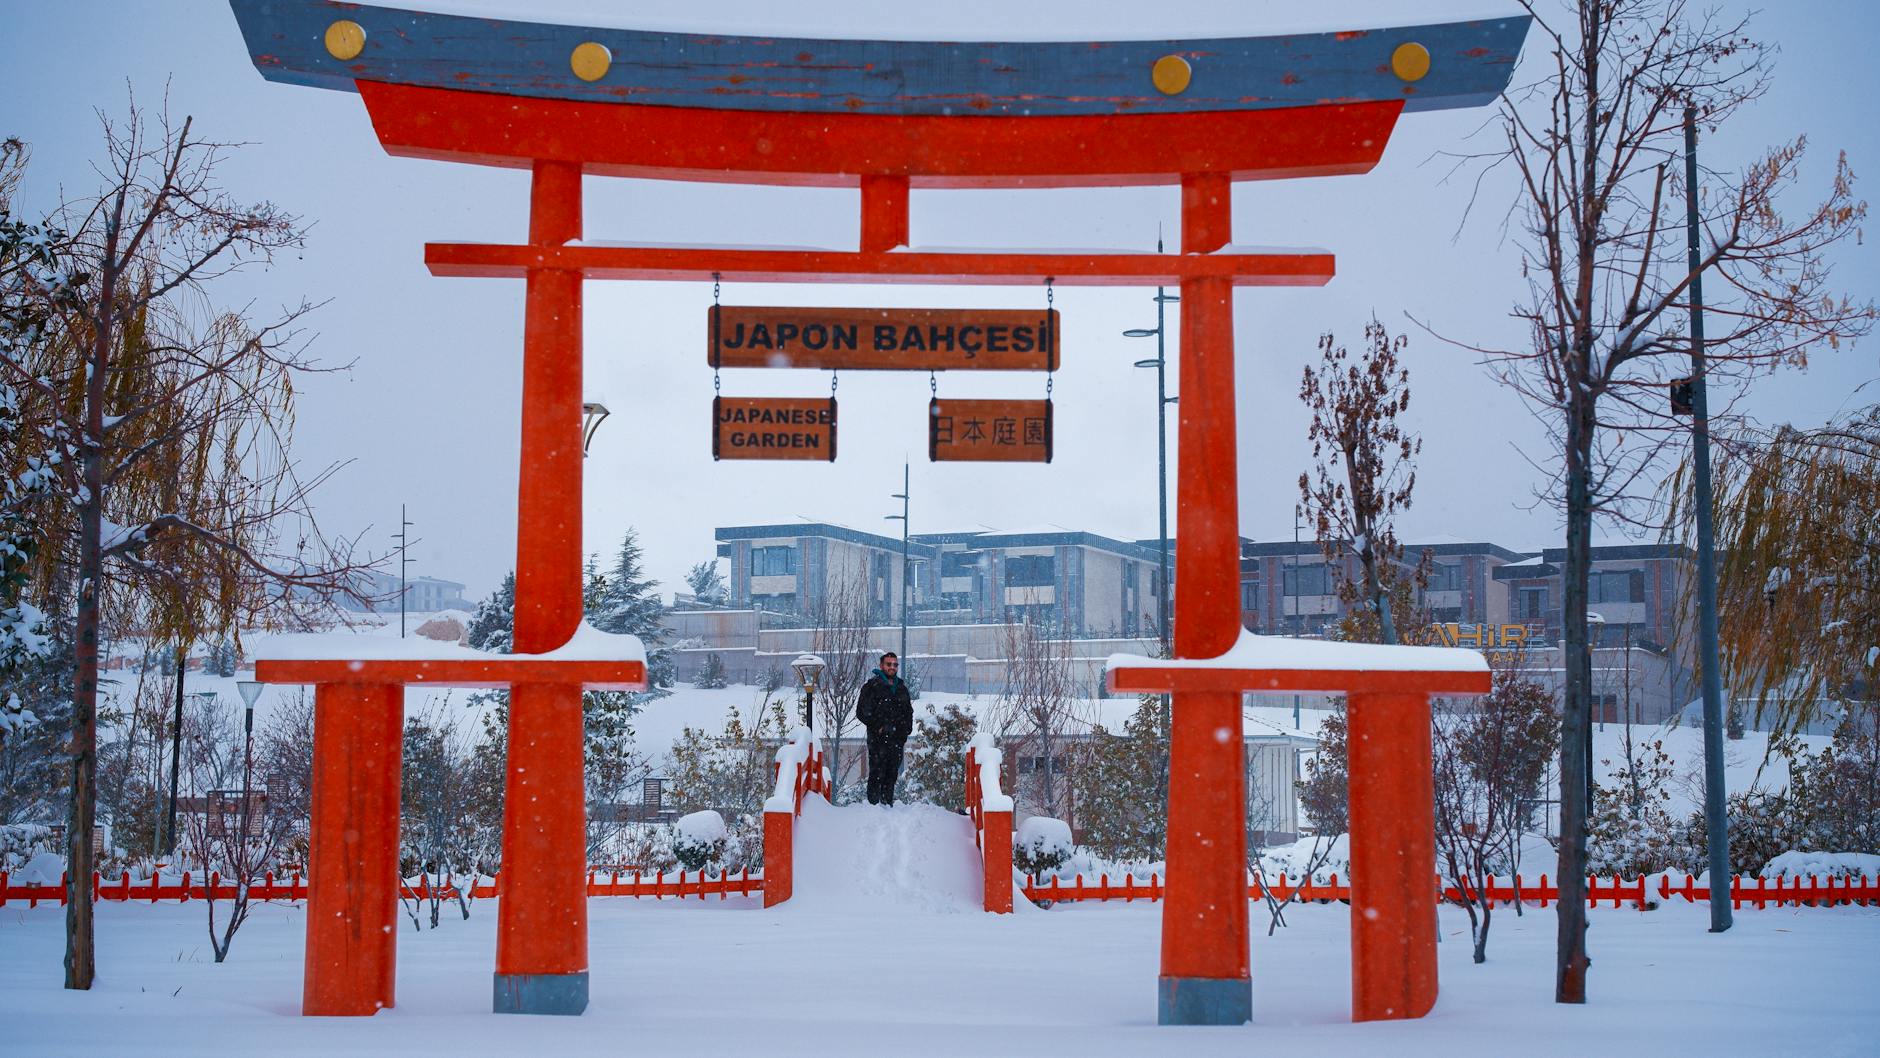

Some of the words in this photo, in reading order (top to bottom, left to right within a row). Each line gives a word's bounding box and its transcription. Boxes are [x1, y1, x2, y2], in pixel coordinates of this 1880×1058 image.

[724, 323, 858, 350] JAPON
[874, 320, 1046, 358] BAHÇESİ
[720, 408, 831, 424] JAPANESE
[731, 432, 819, 448] GARDEN
[937, 416, 1047, 445] 日本庭園
